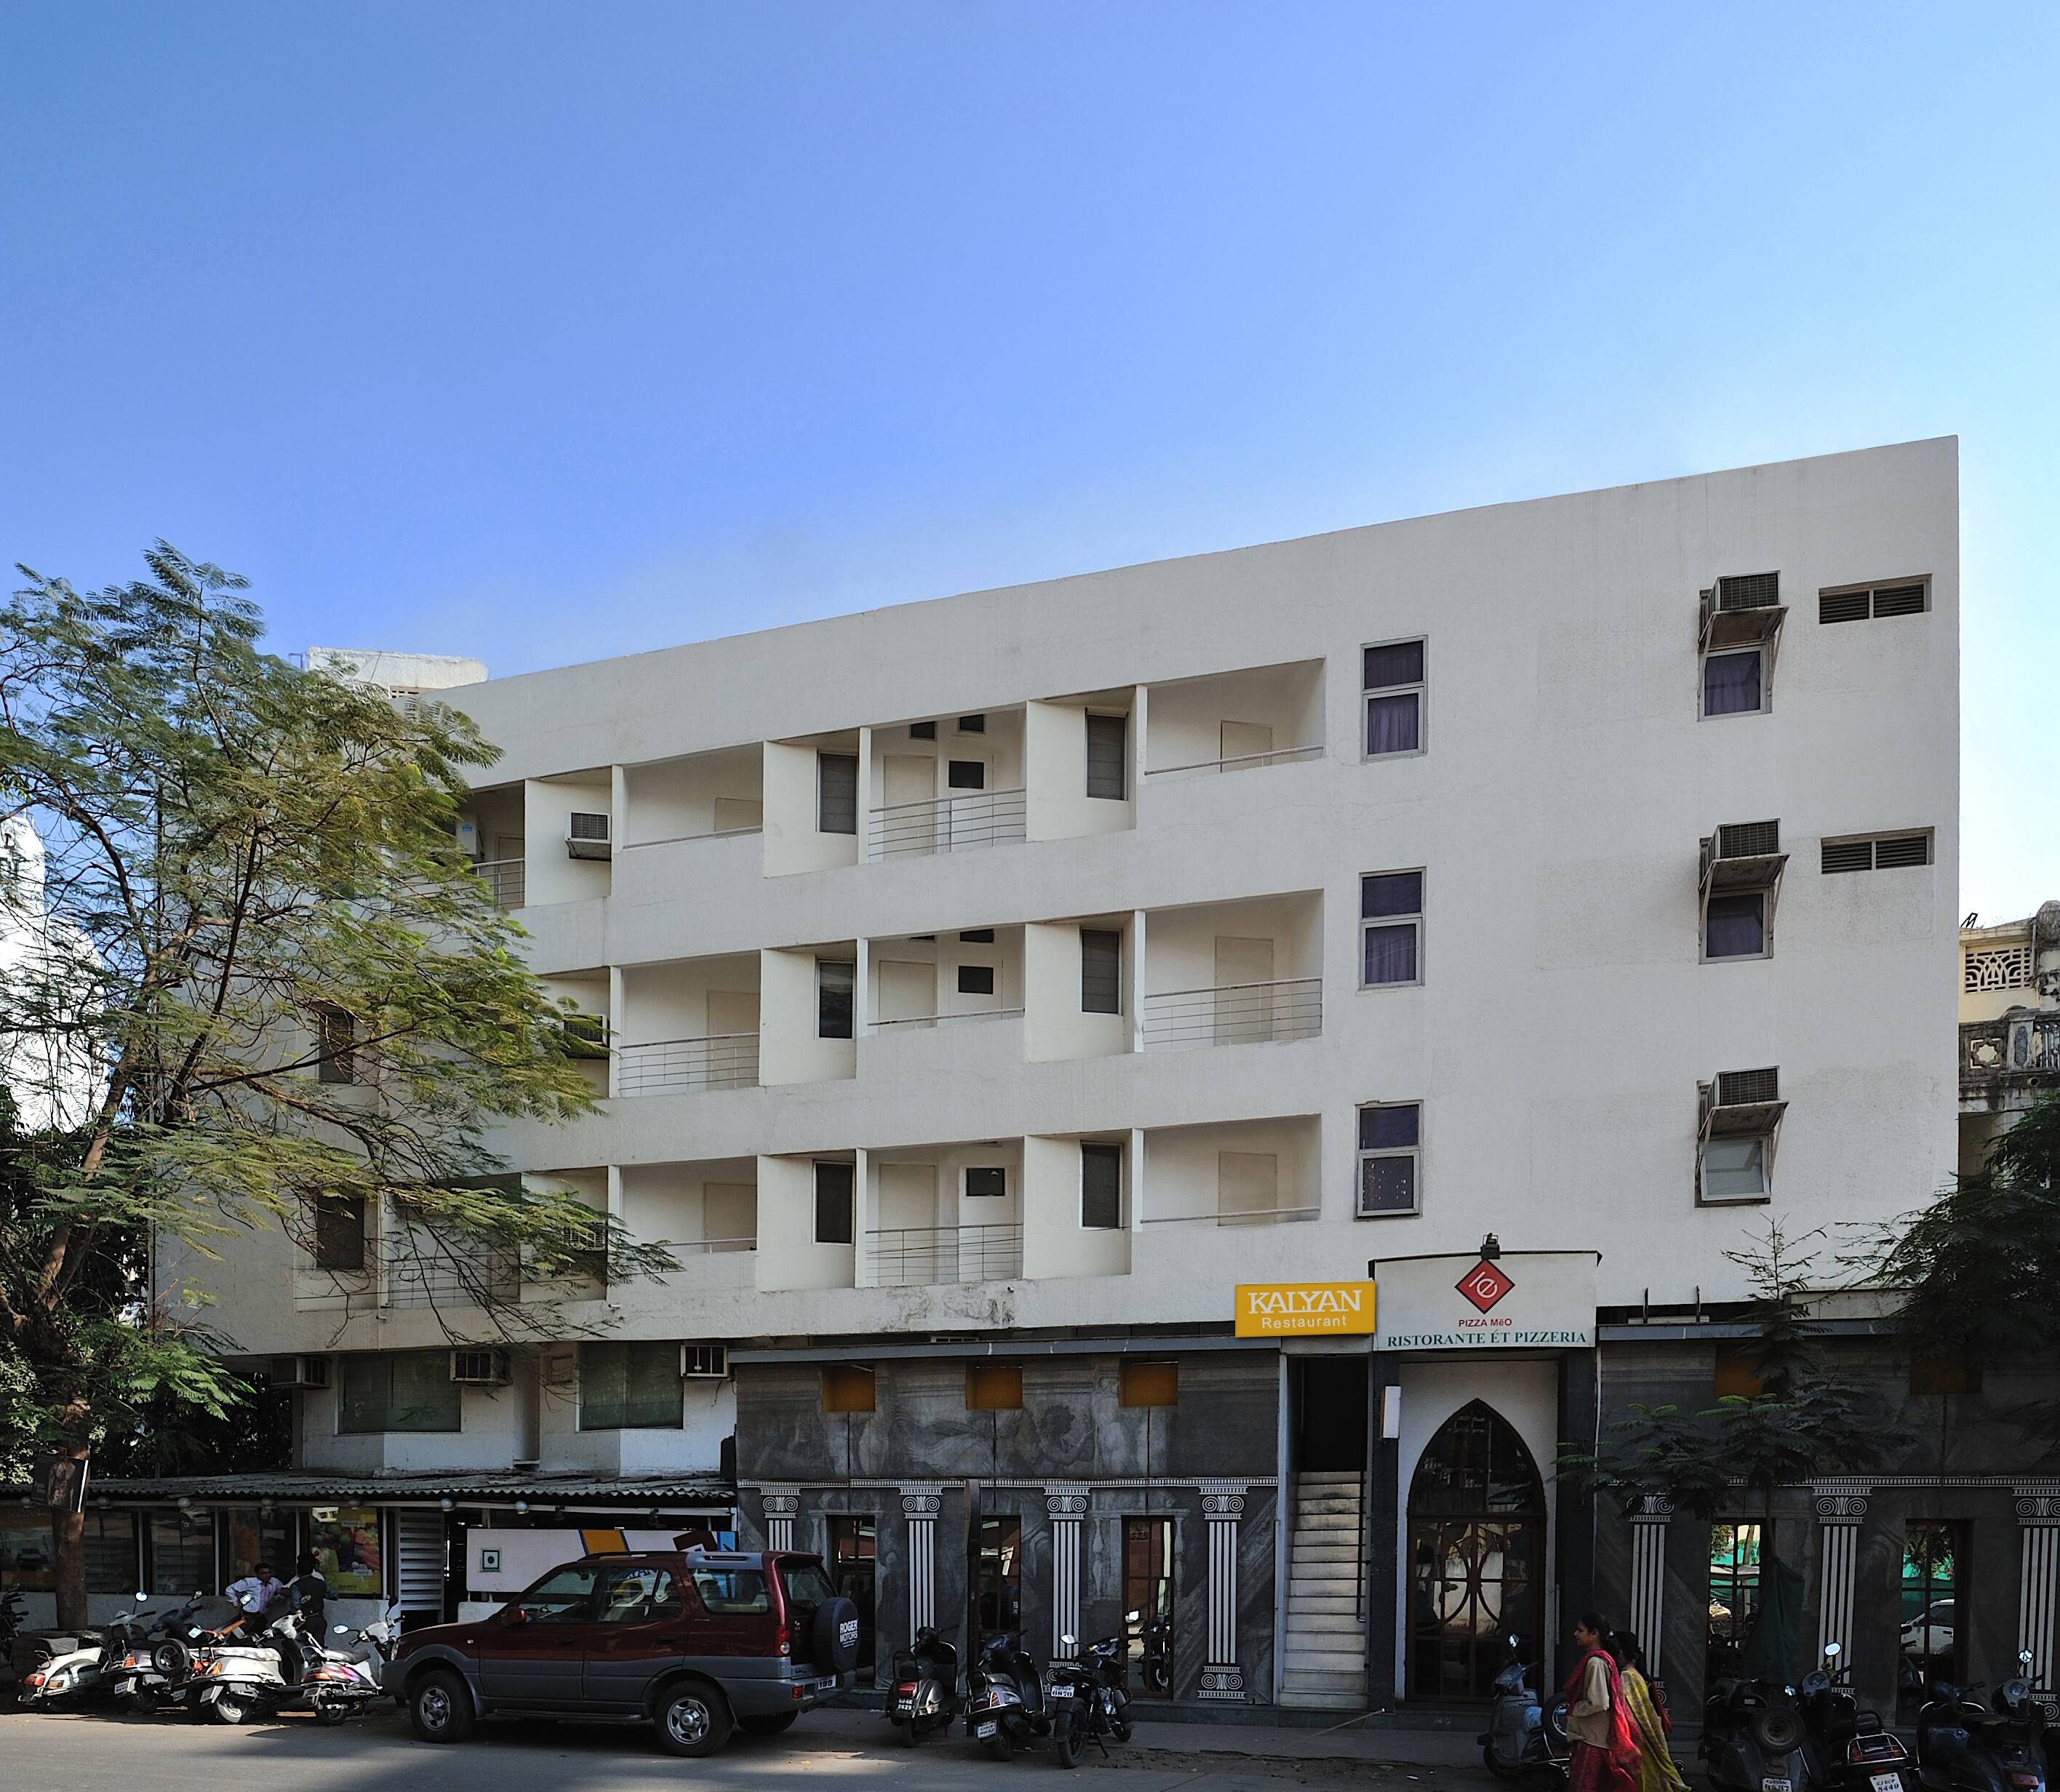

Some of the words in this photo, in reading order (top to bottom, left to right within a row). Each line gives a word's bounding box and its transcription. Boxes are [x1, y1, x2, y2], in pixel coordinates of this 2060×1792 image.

[1247, 1289, 1362, 1313] KALYAN
[1262, 1315, 1346, 1329] Restaurant
[1458, 1319, 1488, 1327] PIZZA
[1388, 1333, 1485, 1347] RISTORANTE
[1514, 1332, 1586, 1343] PIZZERIA
[840, 1620, 858, 1633] ROGER
[840, 1631, 858, 1642] MOTORS
[819, 1679, 833, 1687] 199
